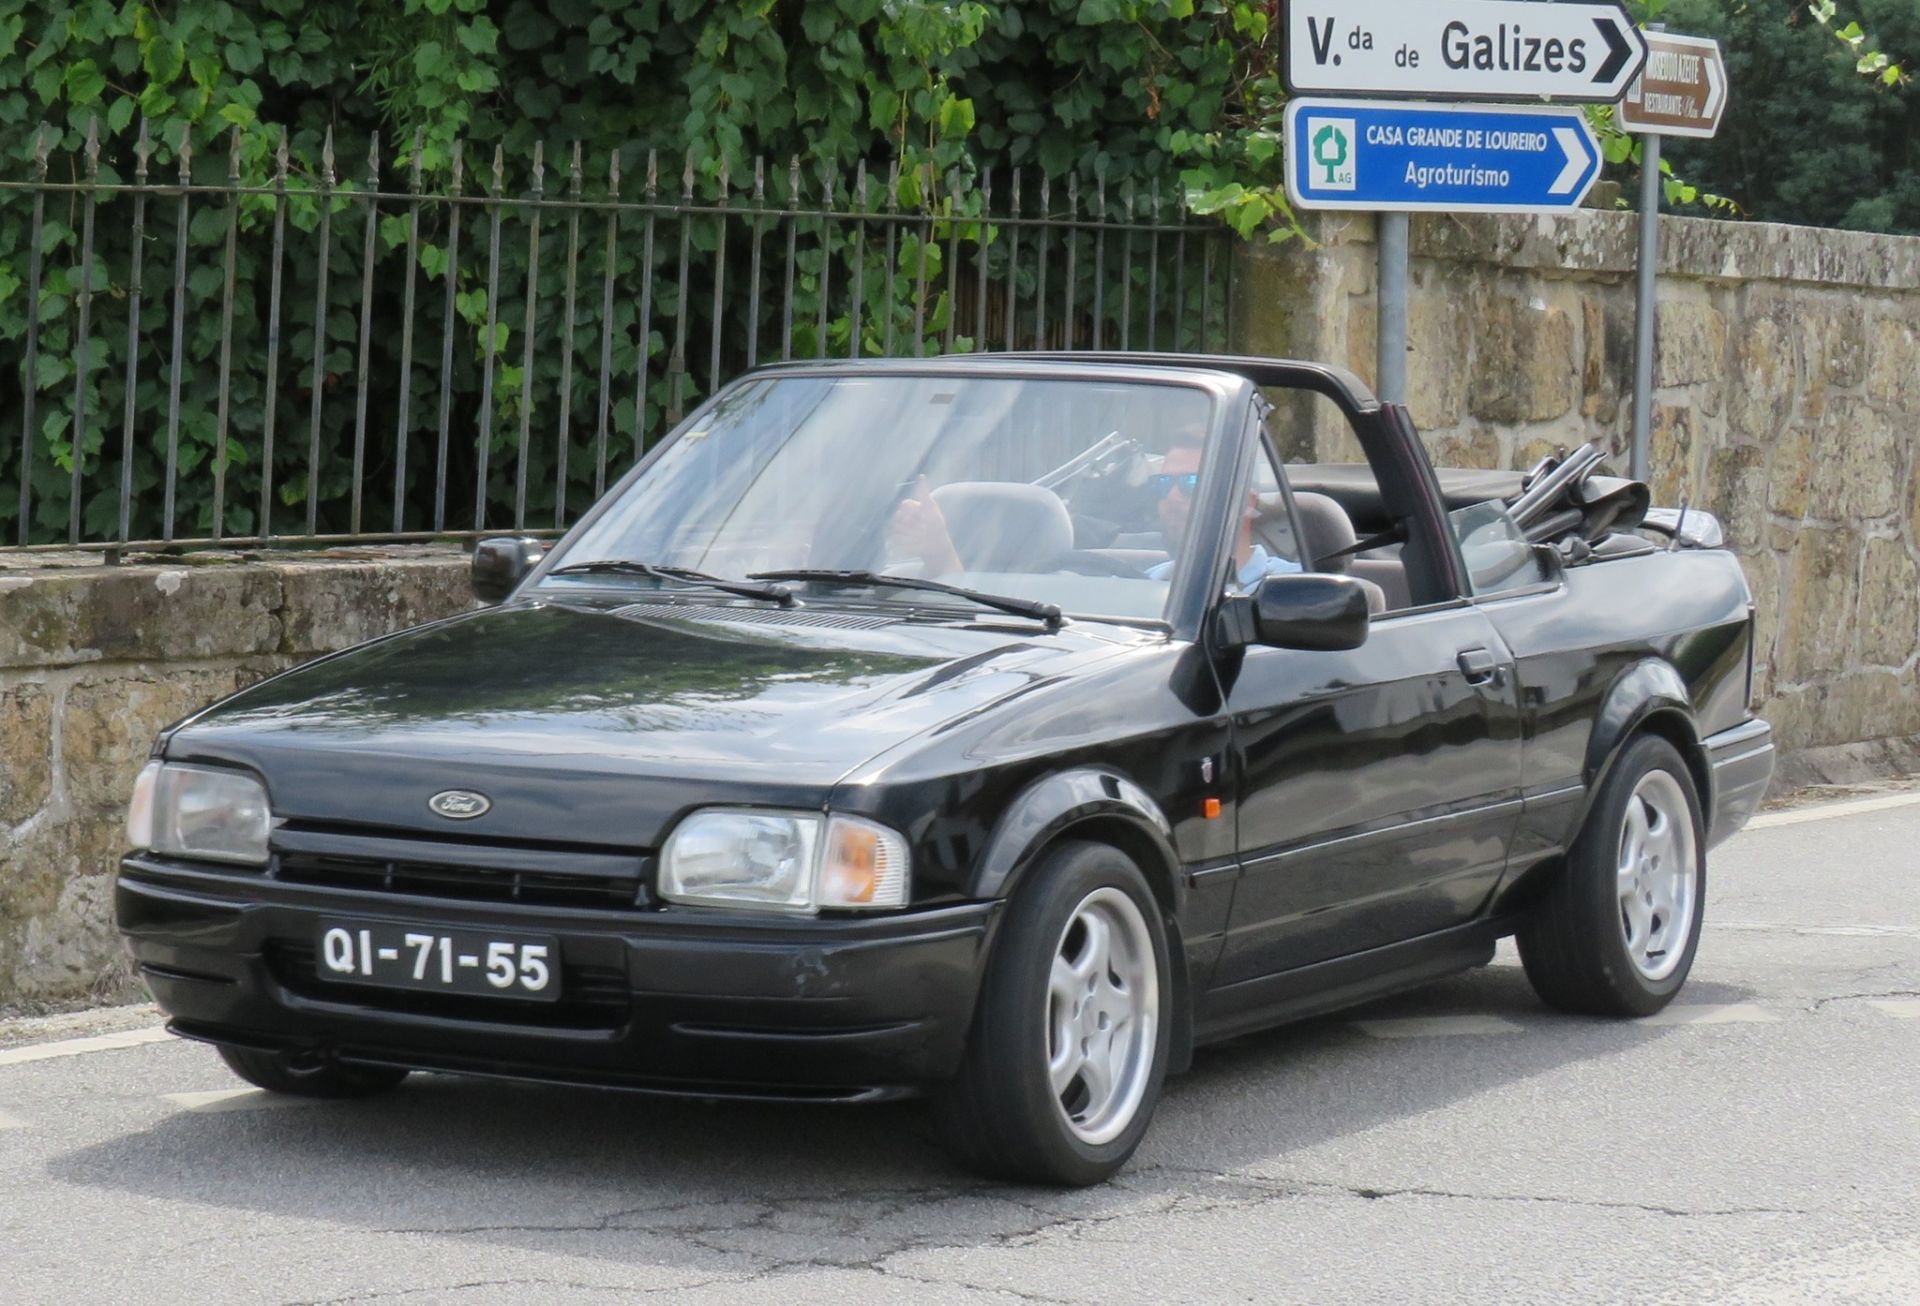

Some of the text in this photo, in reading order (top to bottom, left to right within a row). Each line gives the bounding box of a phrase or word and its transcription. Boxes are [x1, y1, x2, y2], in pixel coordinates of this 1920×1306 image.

[1348, 25, 1373, 50] da
[1395, 44, 1419, 68] de
[1441, 20, 1586, 73] Galizes
[1366, 125, 1547, 152] CASA GRANDE DE LOUREIRO
[1338, 172, 1352, 184] AG
[1404, 161, 1509, 188] Agroturismo
[441, 795, 476, 813] Ford
[324, 927, 550, 991] QI-71-55
